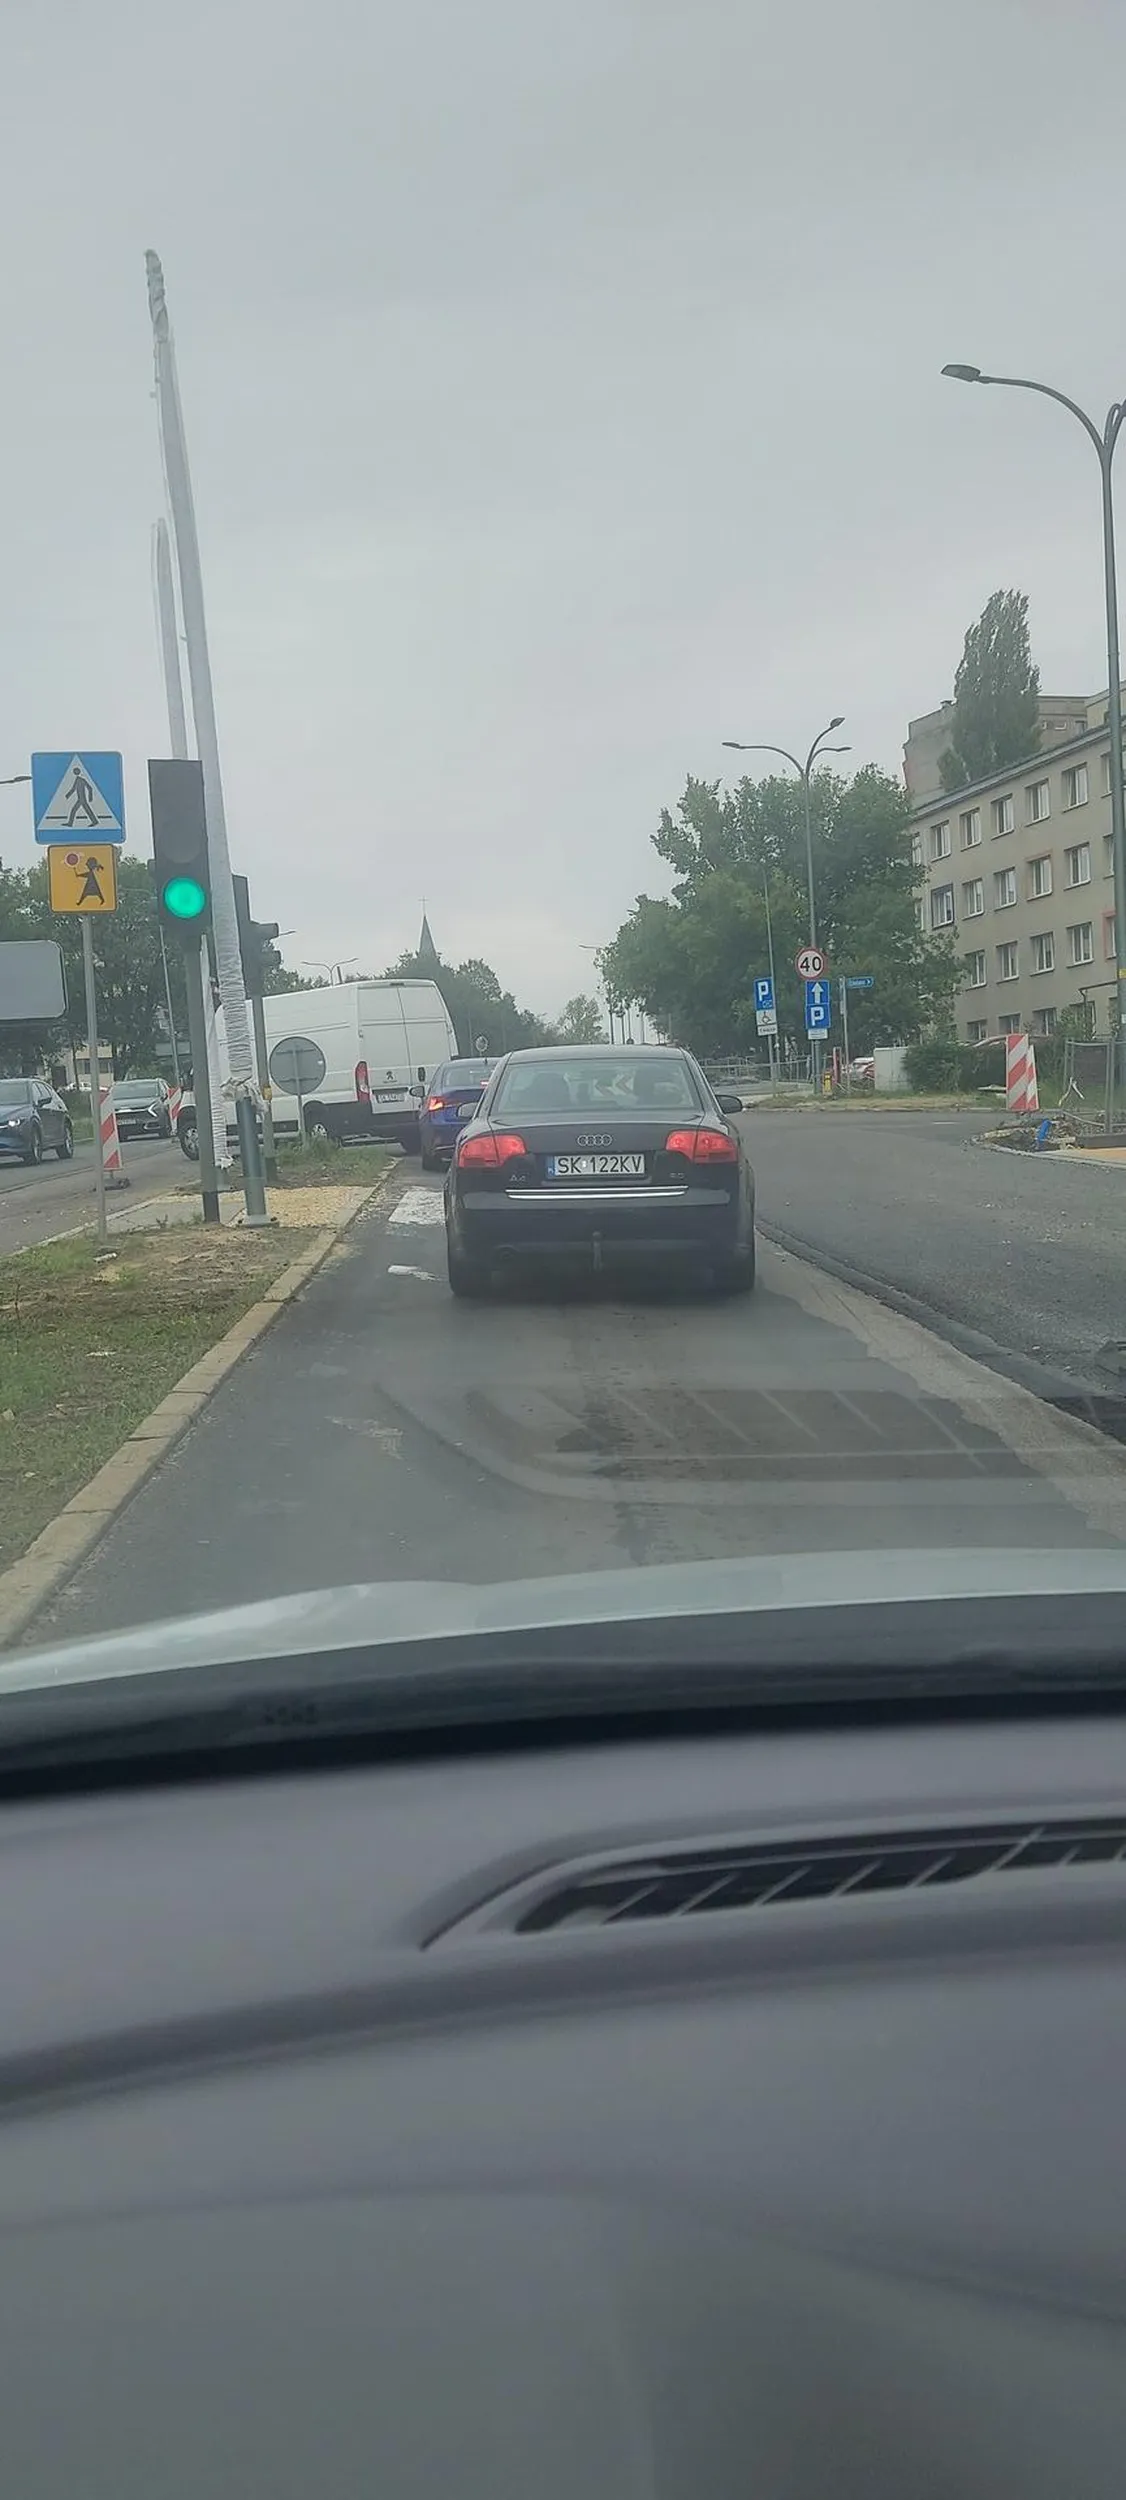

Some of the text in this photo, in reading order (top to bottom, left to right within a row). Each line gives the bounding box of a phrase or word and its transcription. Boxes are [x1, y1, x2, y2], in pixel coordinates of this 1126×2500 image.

[800, 957, 821, 972] 40
[758, 981, 768, 1001] P
[811, 1007, 824, 1026] P
[557, 1157, 582, 1174] SK
[590, 1156, 642, 1173] 122KV
